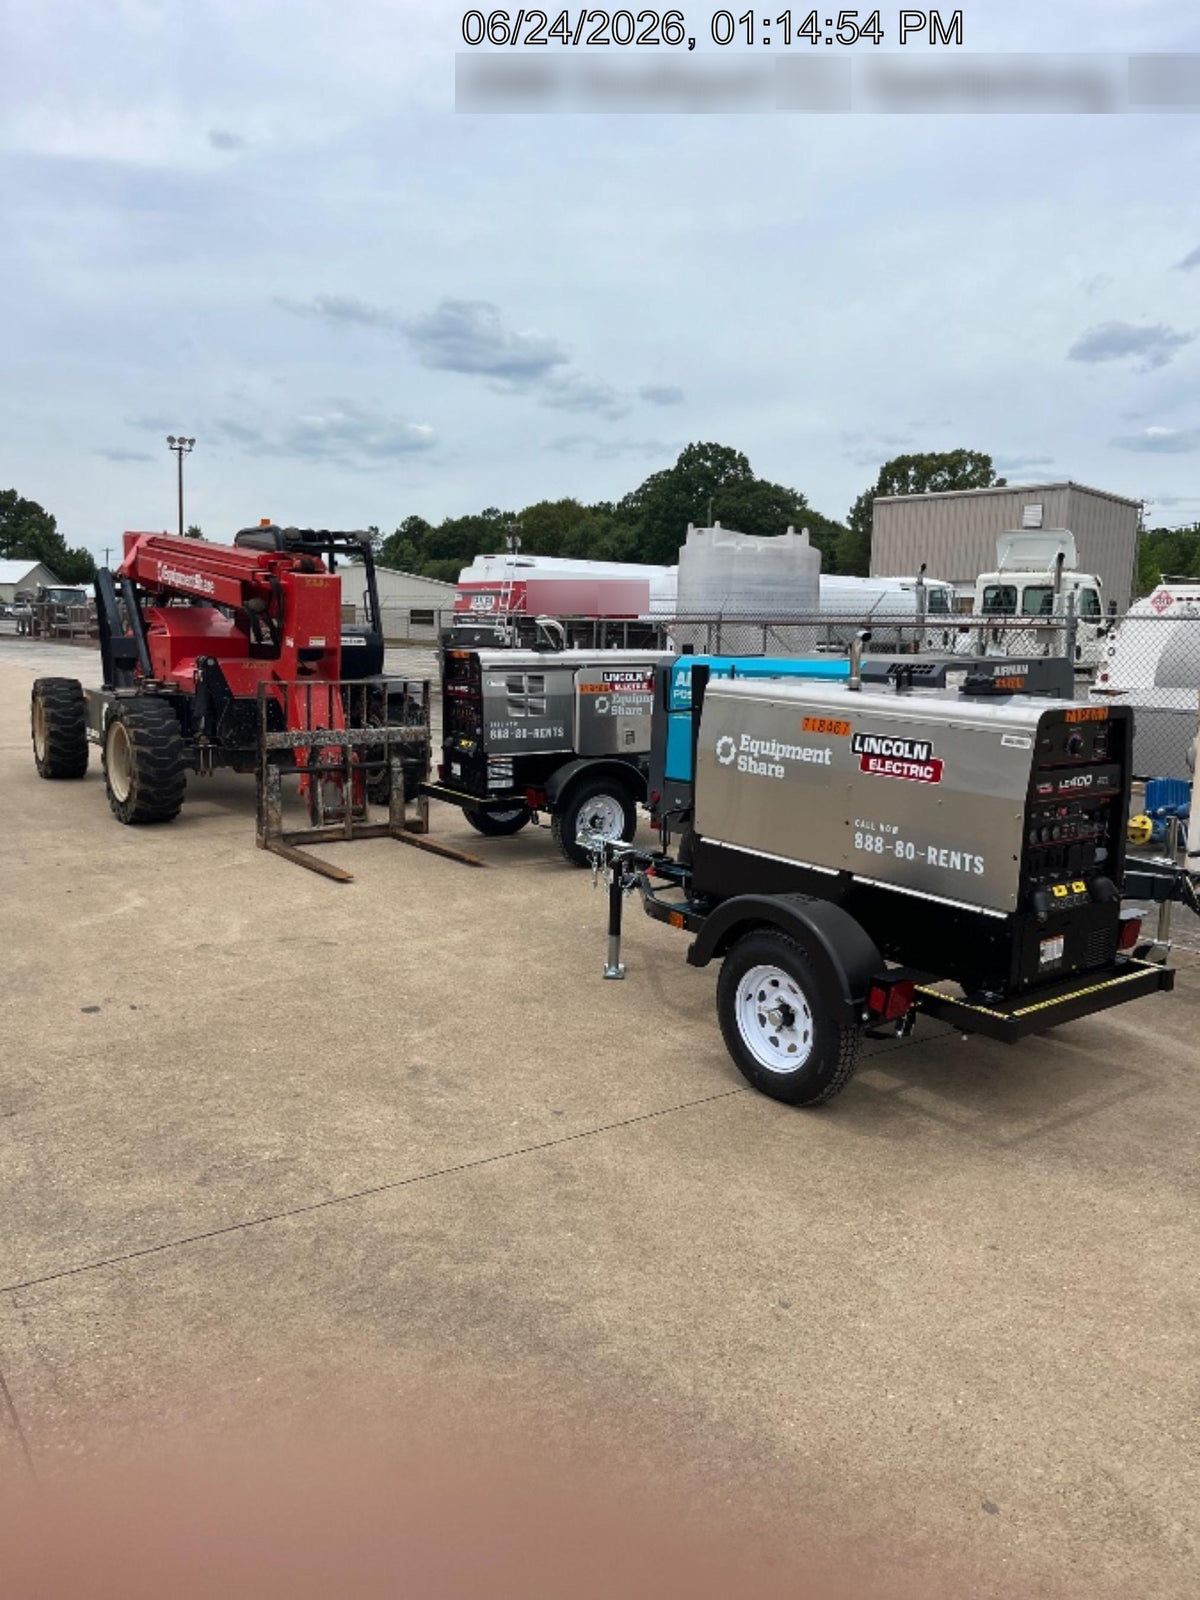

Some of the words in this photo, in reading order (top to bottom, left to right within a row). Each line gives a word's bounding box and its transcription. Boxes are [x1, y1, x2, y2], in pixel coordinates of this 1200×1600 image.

[611, 705, 643, 716] Share
[739, 734, 833, 766] Equipment
[854, 735, 928, 762] LINCOLN
[737, 755, 786, 779] Share
[868, 758, 934, 779] ELECTRIC
[854, 818, 876, 831] CALL
[854, 831, 985, 875] 888-80-RENTS
